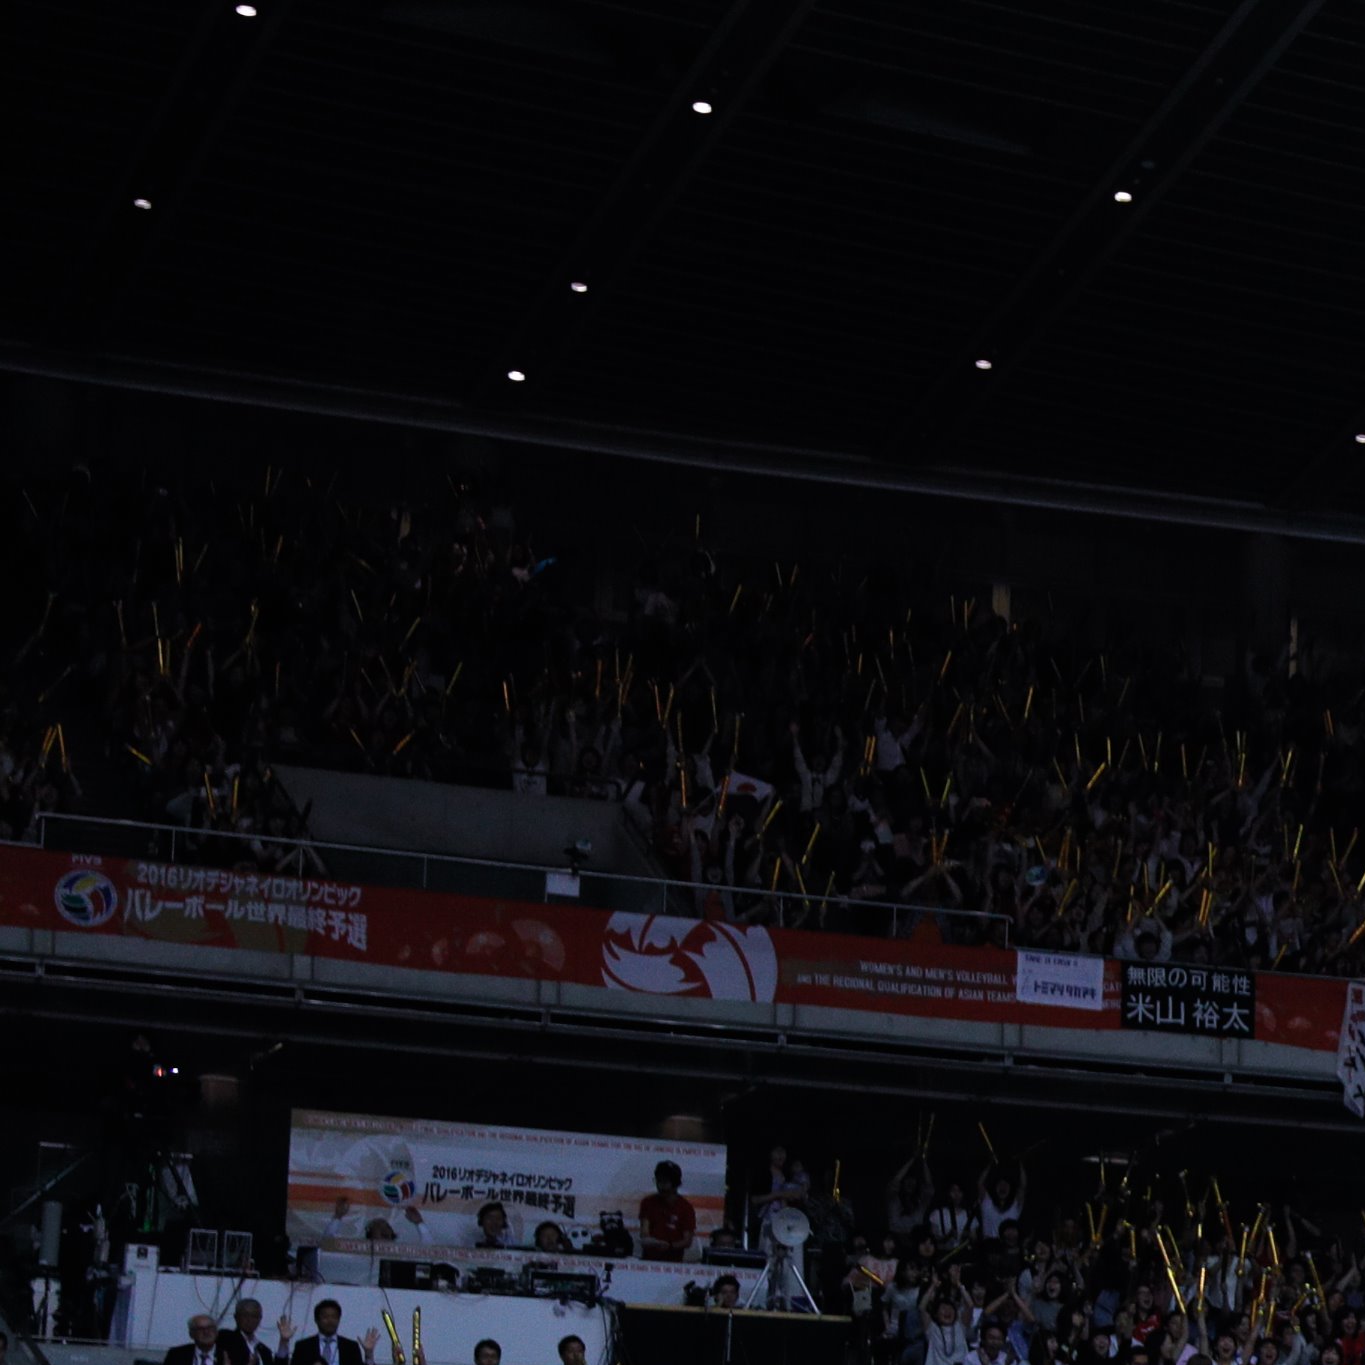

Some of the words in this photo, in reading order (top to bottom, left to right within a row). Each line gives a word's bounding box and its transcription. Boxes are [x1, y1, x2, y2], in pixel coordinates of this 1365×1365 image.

[1126, 964, 1251, 997] 無限の可能性
[1126, 992, 1250, 1033] 米山裕太
[432, 1165, 573, 1191] 2016リオデジャネイロオリンピック
[422, 1182, 576, 1219] バレーボール世界最終予選
